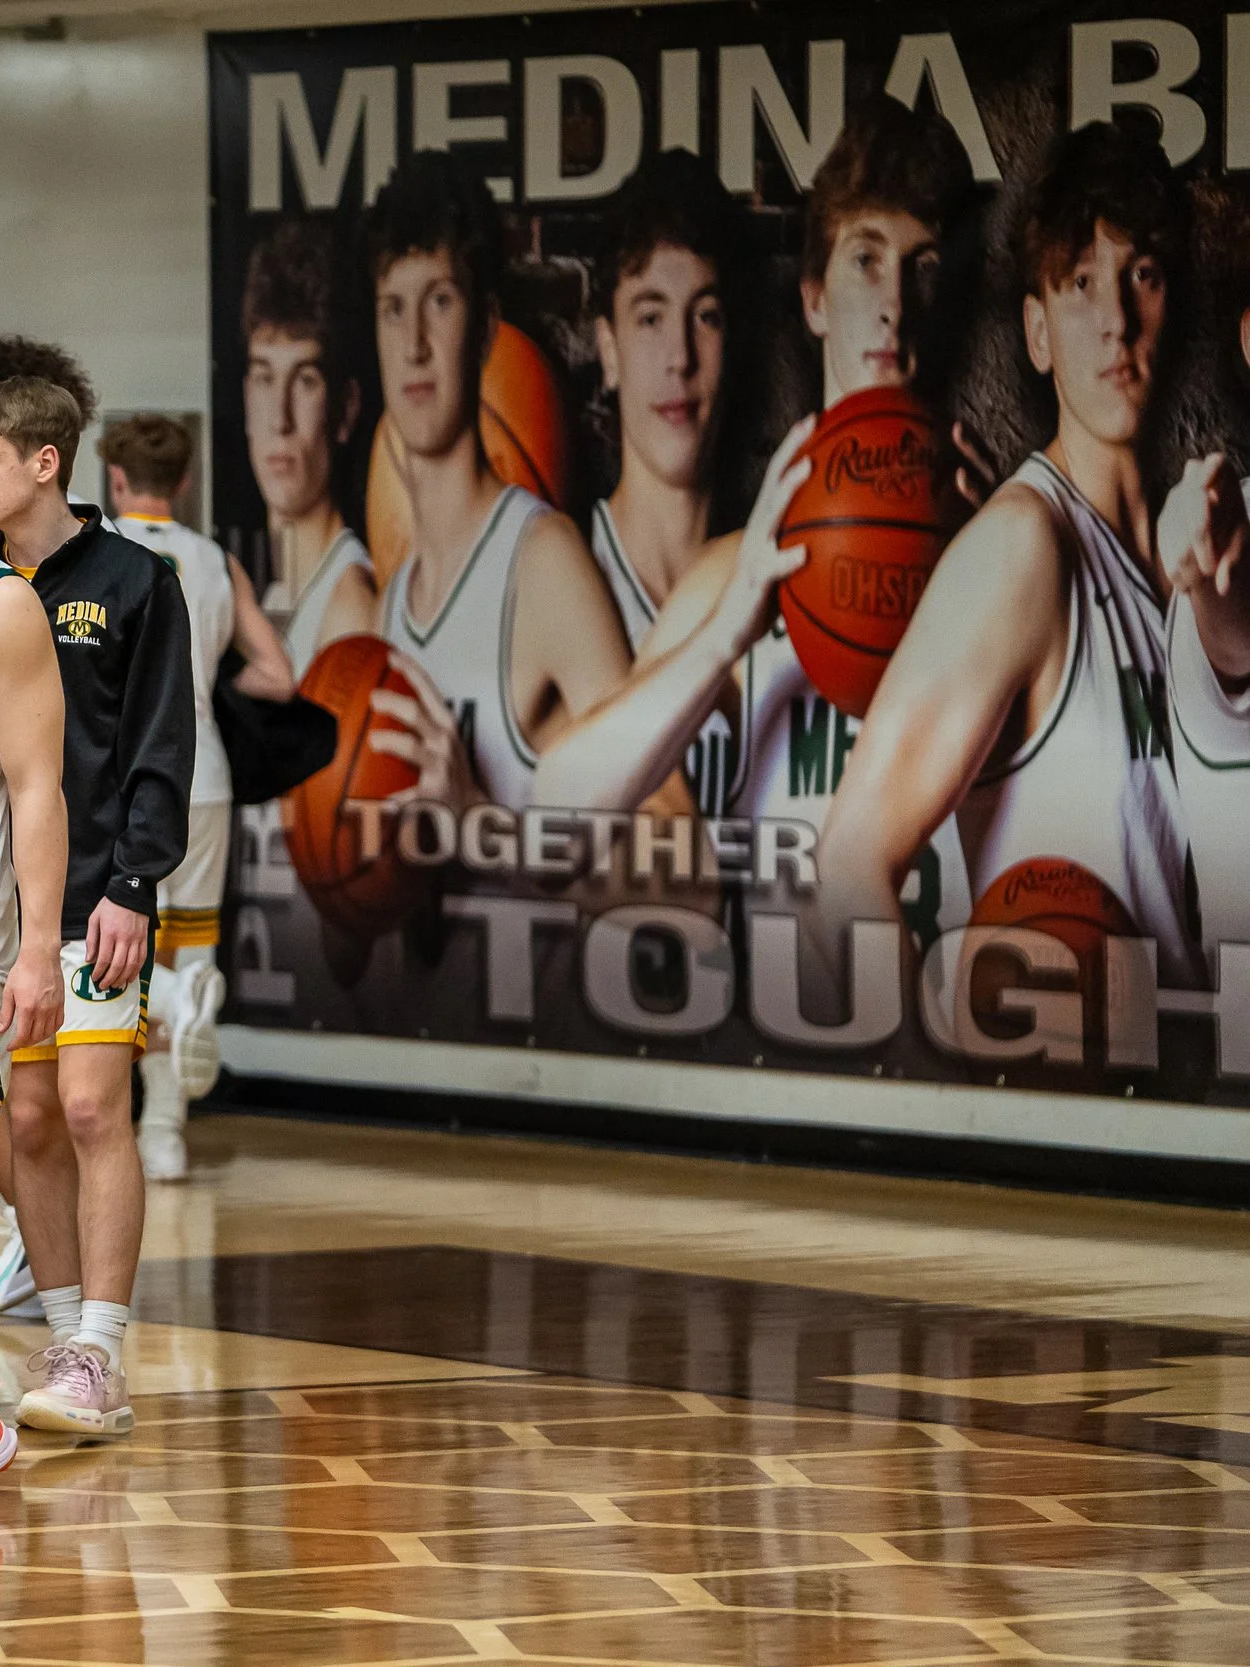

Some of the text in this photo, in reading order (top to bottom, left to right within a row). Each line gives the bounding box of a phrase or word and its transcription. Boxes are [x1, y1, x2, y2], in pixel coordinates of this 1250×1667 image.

[249, 32, 1002, 212] MEDINA
[56, 601, 106, 629] MEDINA
[57, 635, 101, 646] VOLLEYBALL
[344, 798, 824, 888] TOGETHER
[442, 893, 1250, 1079] TOUGH
